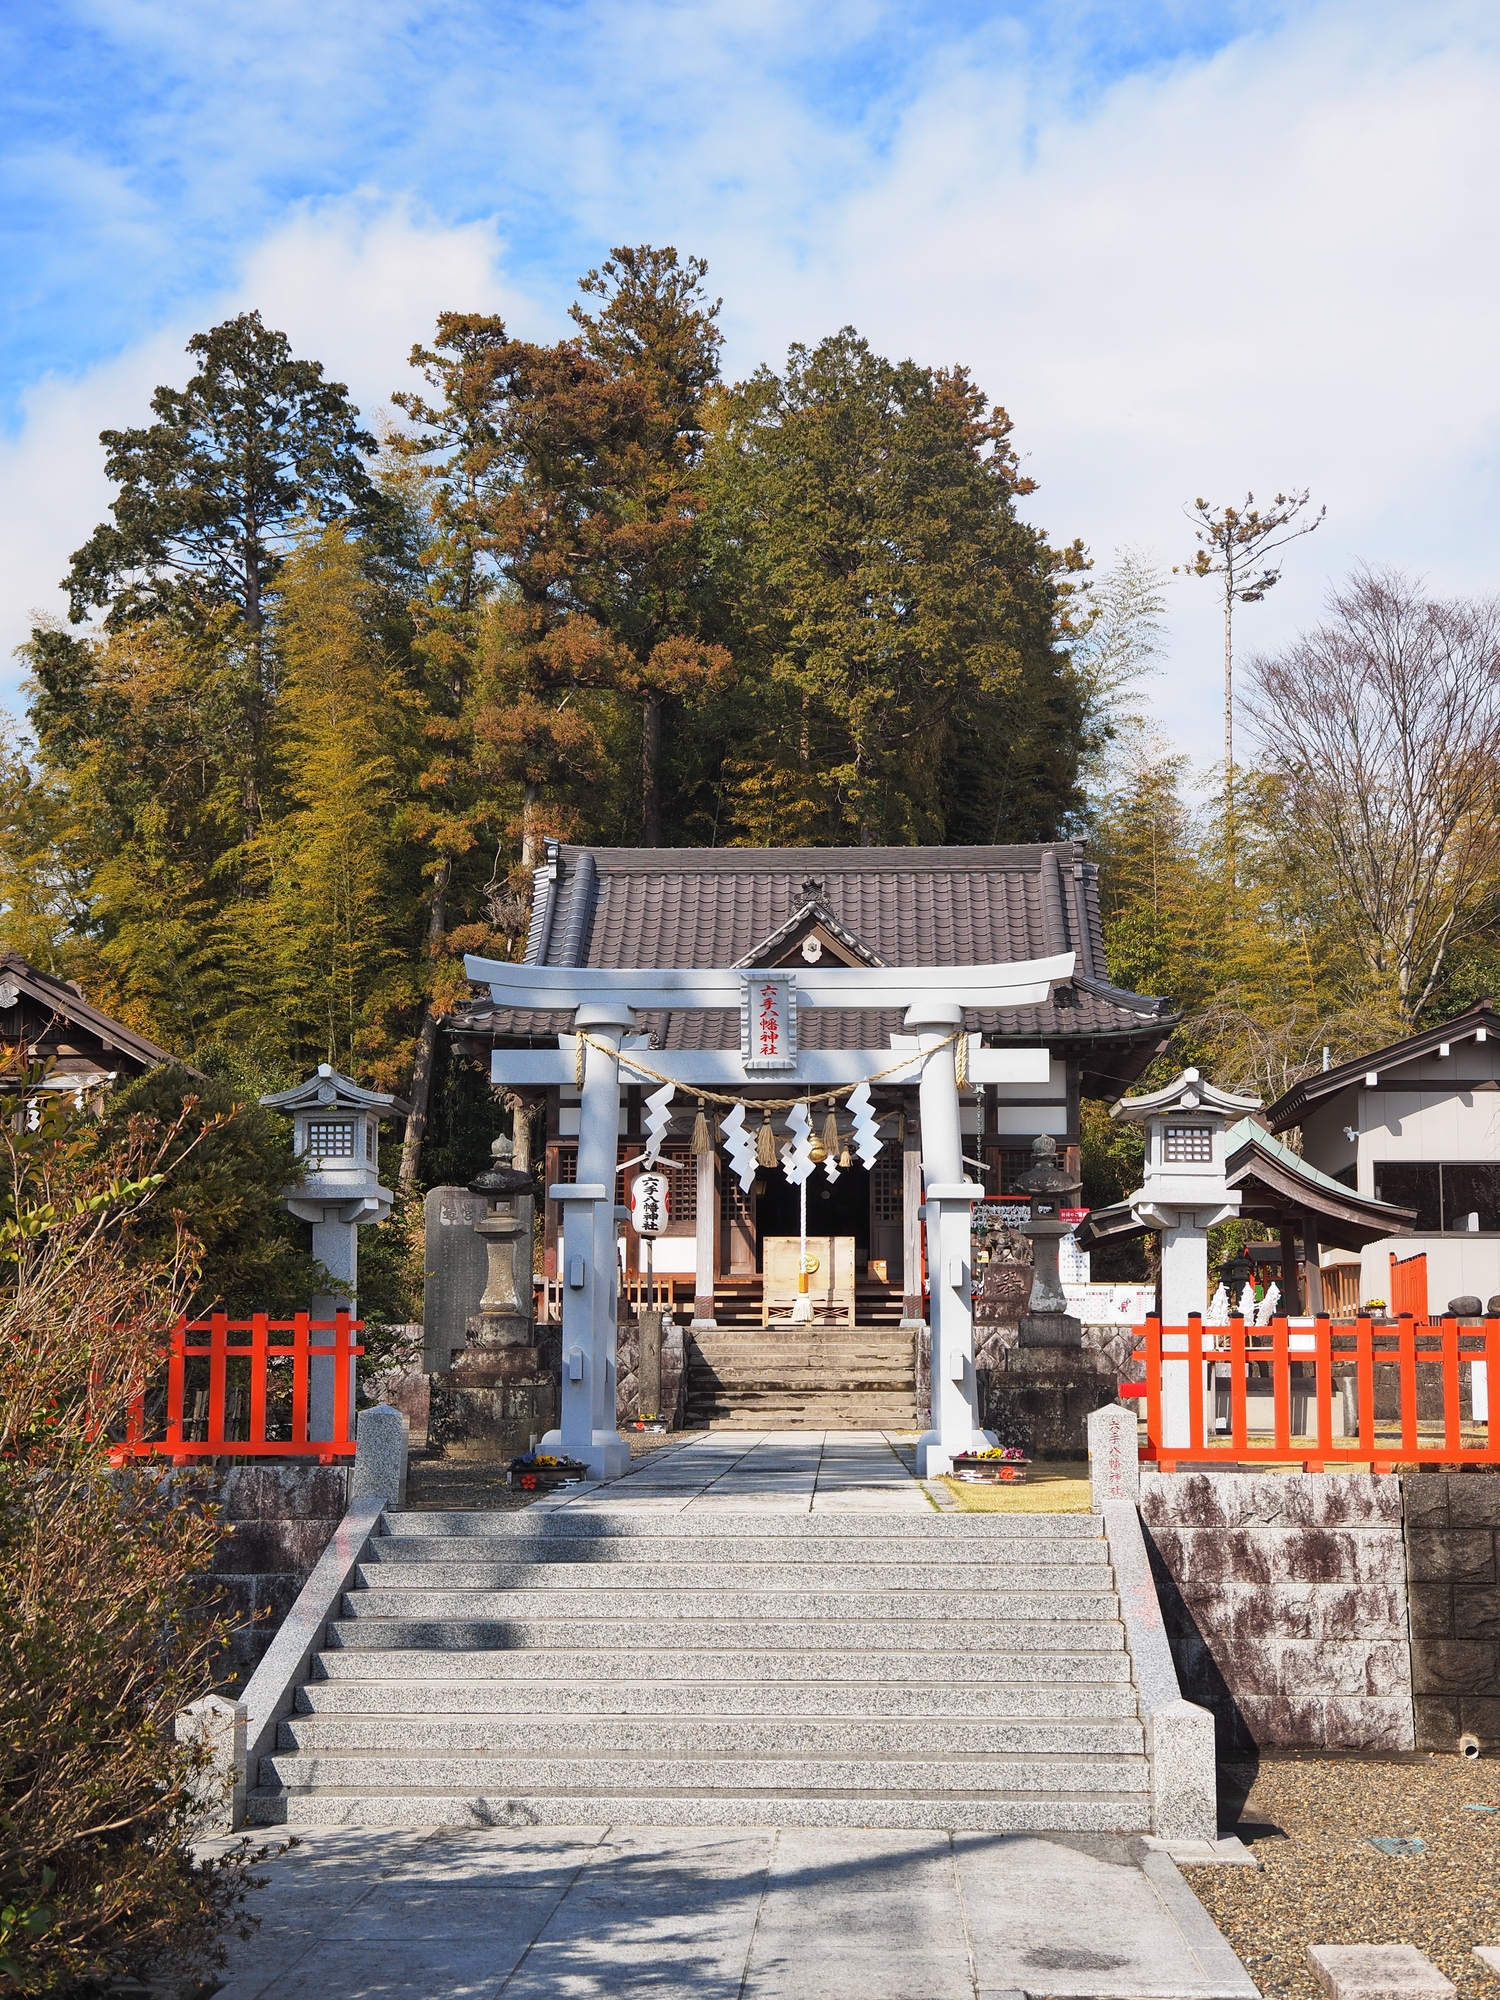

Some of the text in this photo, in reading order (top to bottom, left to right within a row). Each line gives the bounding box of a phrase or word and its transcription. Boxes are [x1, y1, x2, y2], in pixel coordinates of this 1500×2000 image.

[759, 985, 779, 1055] 六手八幡神社
[641, 1176, 660, 1231] 六手八幡神社
[1108, 1420, 1123, 1497] 六手八幡神社
